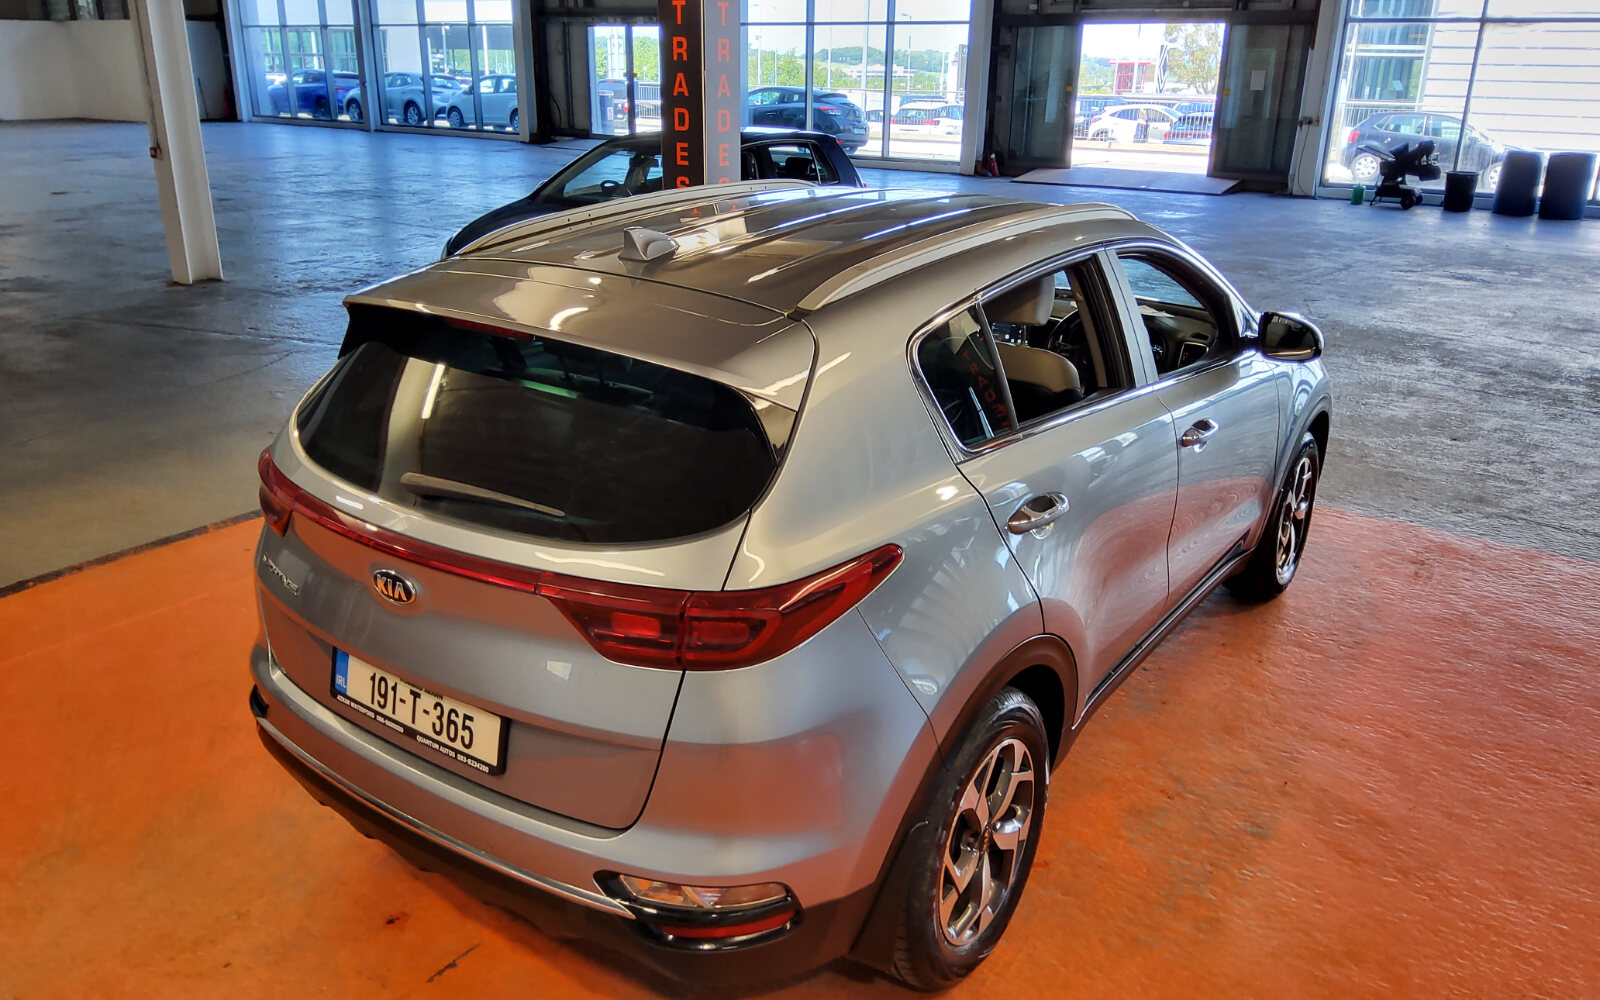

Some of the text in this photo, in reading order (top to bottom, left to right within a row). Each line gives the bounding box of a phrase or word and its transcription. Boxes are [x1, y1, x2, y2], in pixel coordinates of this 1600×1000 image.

[717, 1, 731, 184] TRADE
[377, 574, 407, 601] KIA
[336, 673, 347, 688] IRL
[370, 672, 475, 750] 191-T-365
[440, 746, 456, 758] AUTOS
